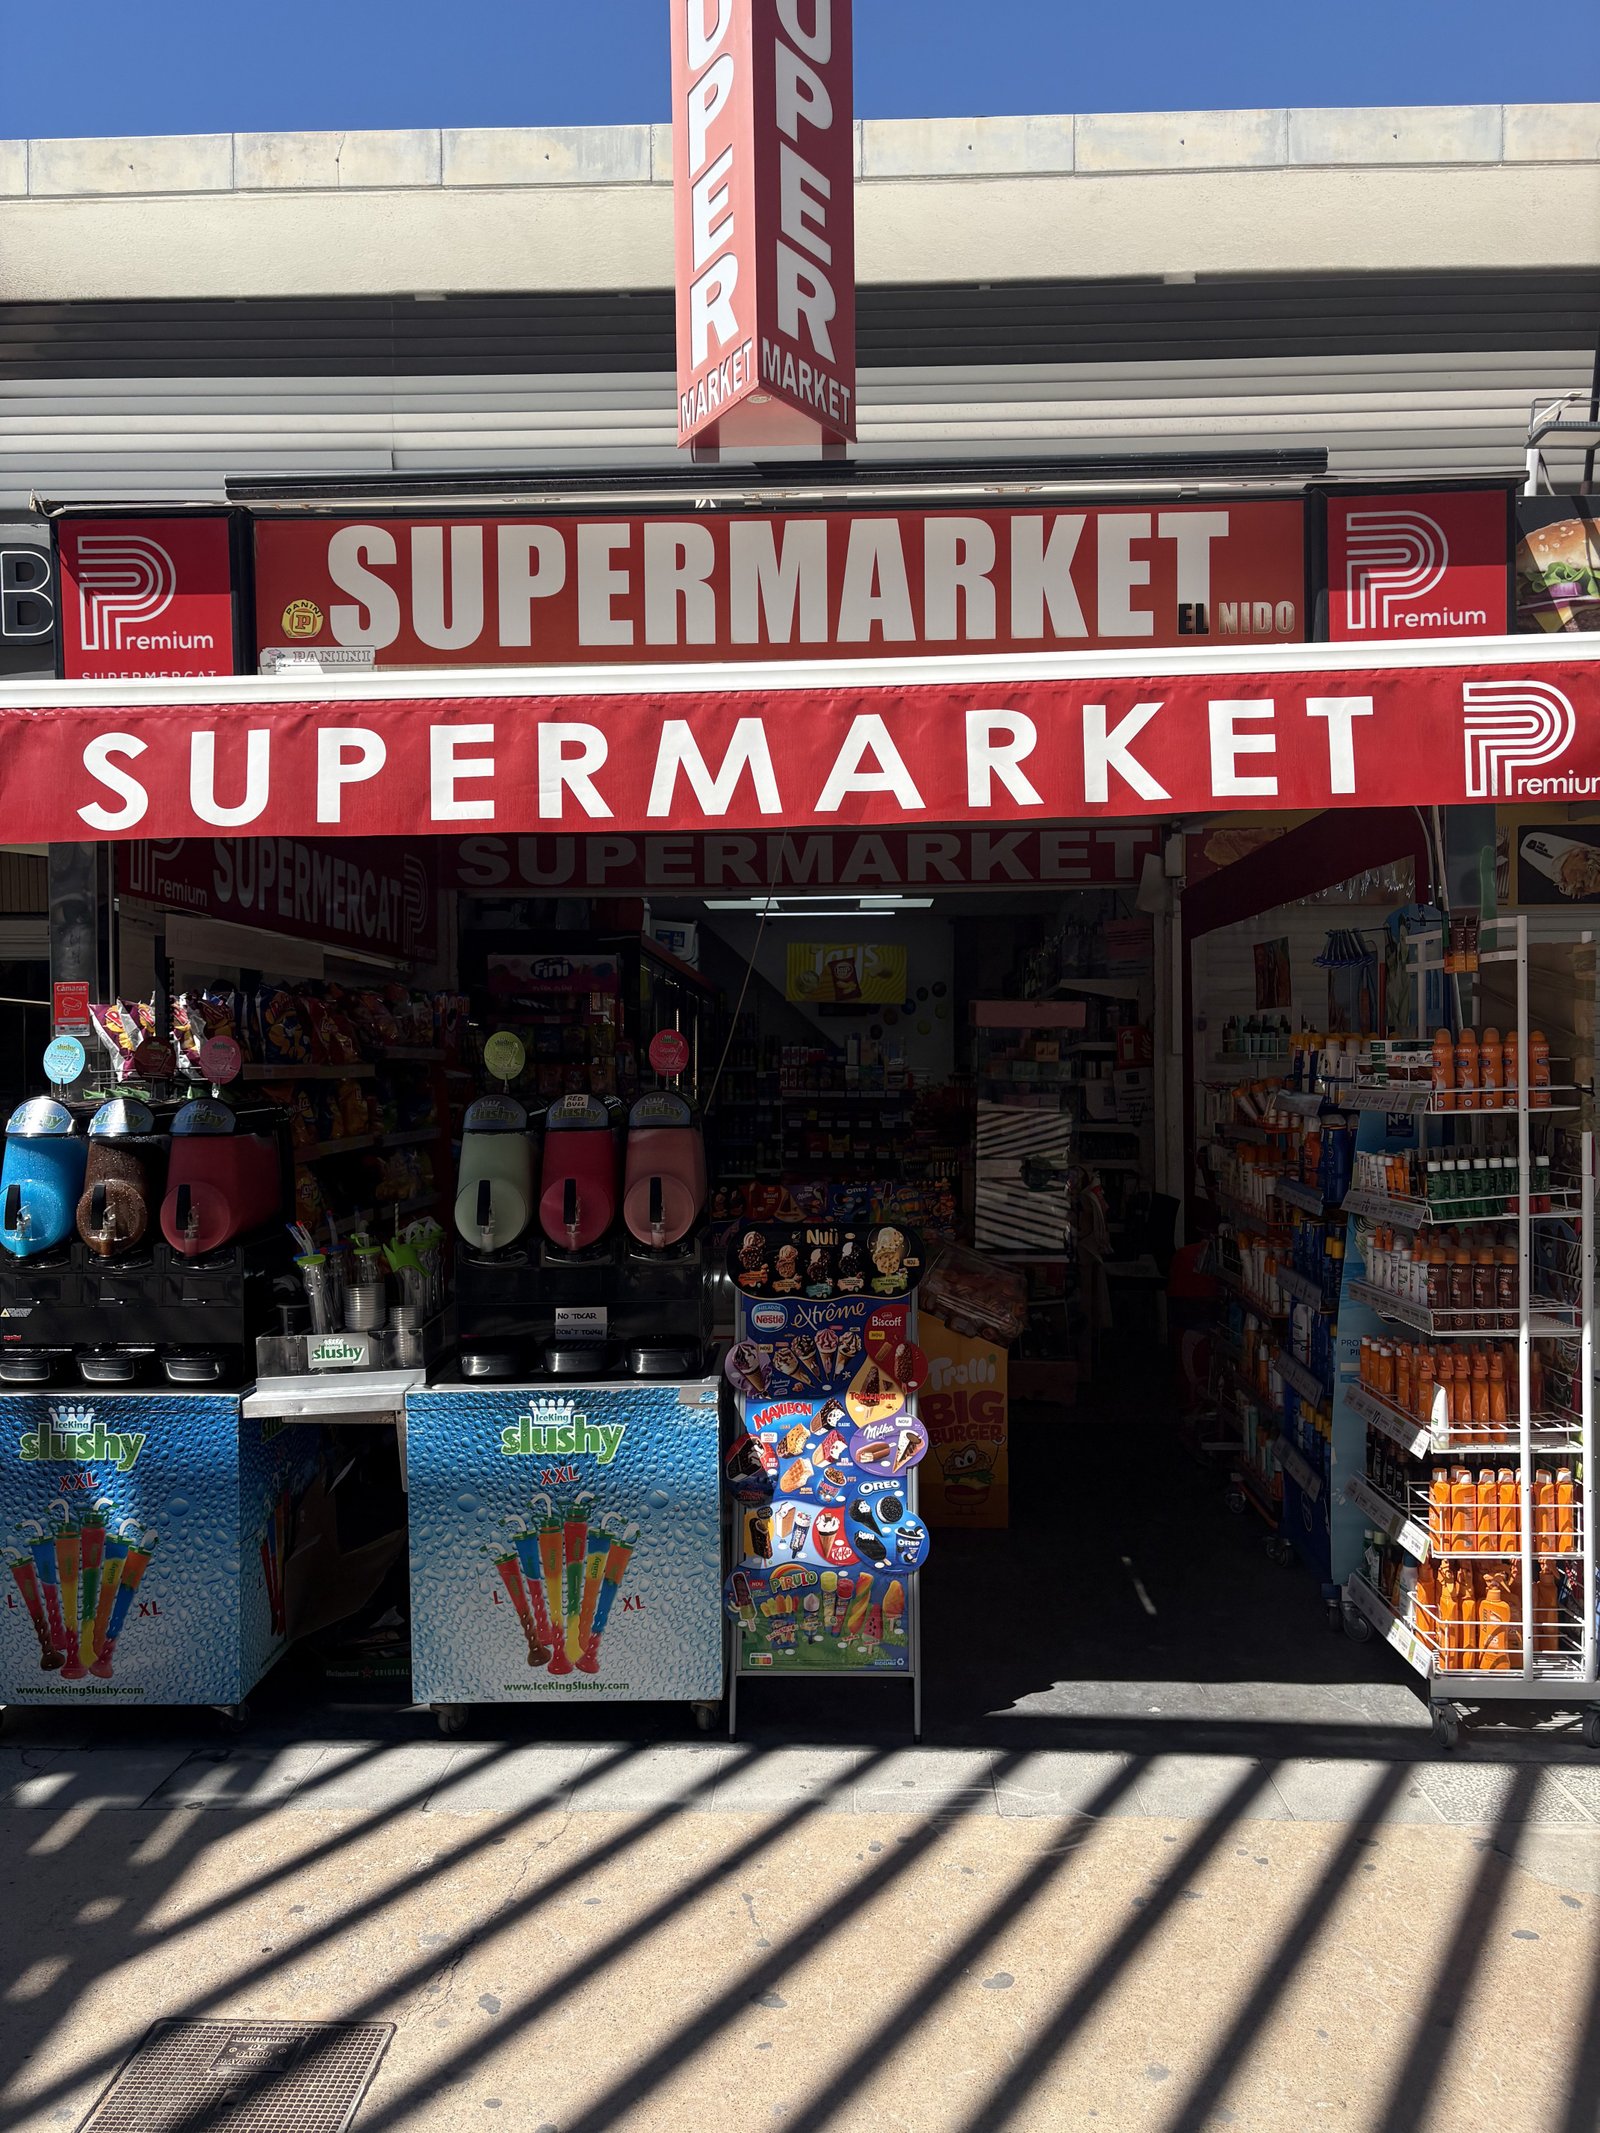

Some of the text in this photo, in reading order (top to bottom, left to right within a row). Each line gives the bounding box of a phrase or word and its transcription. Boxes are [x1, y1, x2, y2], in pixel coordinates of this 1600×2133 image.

[679, 338, 753, 433] MARKET
[762, 337, 851, 426] MARKET
[327, 510, 1230, 652] SUPERMARKET
[286, 601, 322, 617] PANINI
[1177, 600, 1296, 635] EL NIDO
[292, 650, 371, 663] PANINI
[76, 696, 1374, 832] SUPERMARKET
[456, 829, 1153, 887] SUPERMARKET
[213, 837, 401, 944] SUPERMERCAT
[565, 1101, 586, 1109] BULL
[805, 1228, 840, 1246] Nuii
[571, 1312, 597, 1320] TOCAR
[872, 1316, 902, 1327] Biscoff
[312, 1344, 365, 1363] slushy
[927, 1353, 997, 1391] Trolli
[535, 1413, 569, 1422] IceKing
[752, 1402, 813, 1431] MAXIBON
[919, 1390, 1005, 1431] BIG
[55, 1420, 89, 1430] IceKing
[863, 1423, 895, 1435] Milka
[501, 1414, 626, 1465] slushy
[930, 1423, 1005, 1446] BURGER
[19, 1422, 146, 1472] slushy
[58, 1471, 99, 1493] XXL
[539, 1465, 580, 1486] XXL
[859, 1480, 901, 1494] OREO
[897, 1539, 920, 1547] OREO
[7, 1595, 18, 1609] L
[493, 1590, 504, 1605] L
[622, 1595, 646, 1612] XL
[138, 1601, 163, 1617] XL
[16, 1686, 144, 1697] www.IceKingSlushy.com
[503, 1681, 631, 1693] www.IceKingSlushy.com
[235, 2051, 272, 2059] SALOU
[247, 2044, 269, 2052] DE
